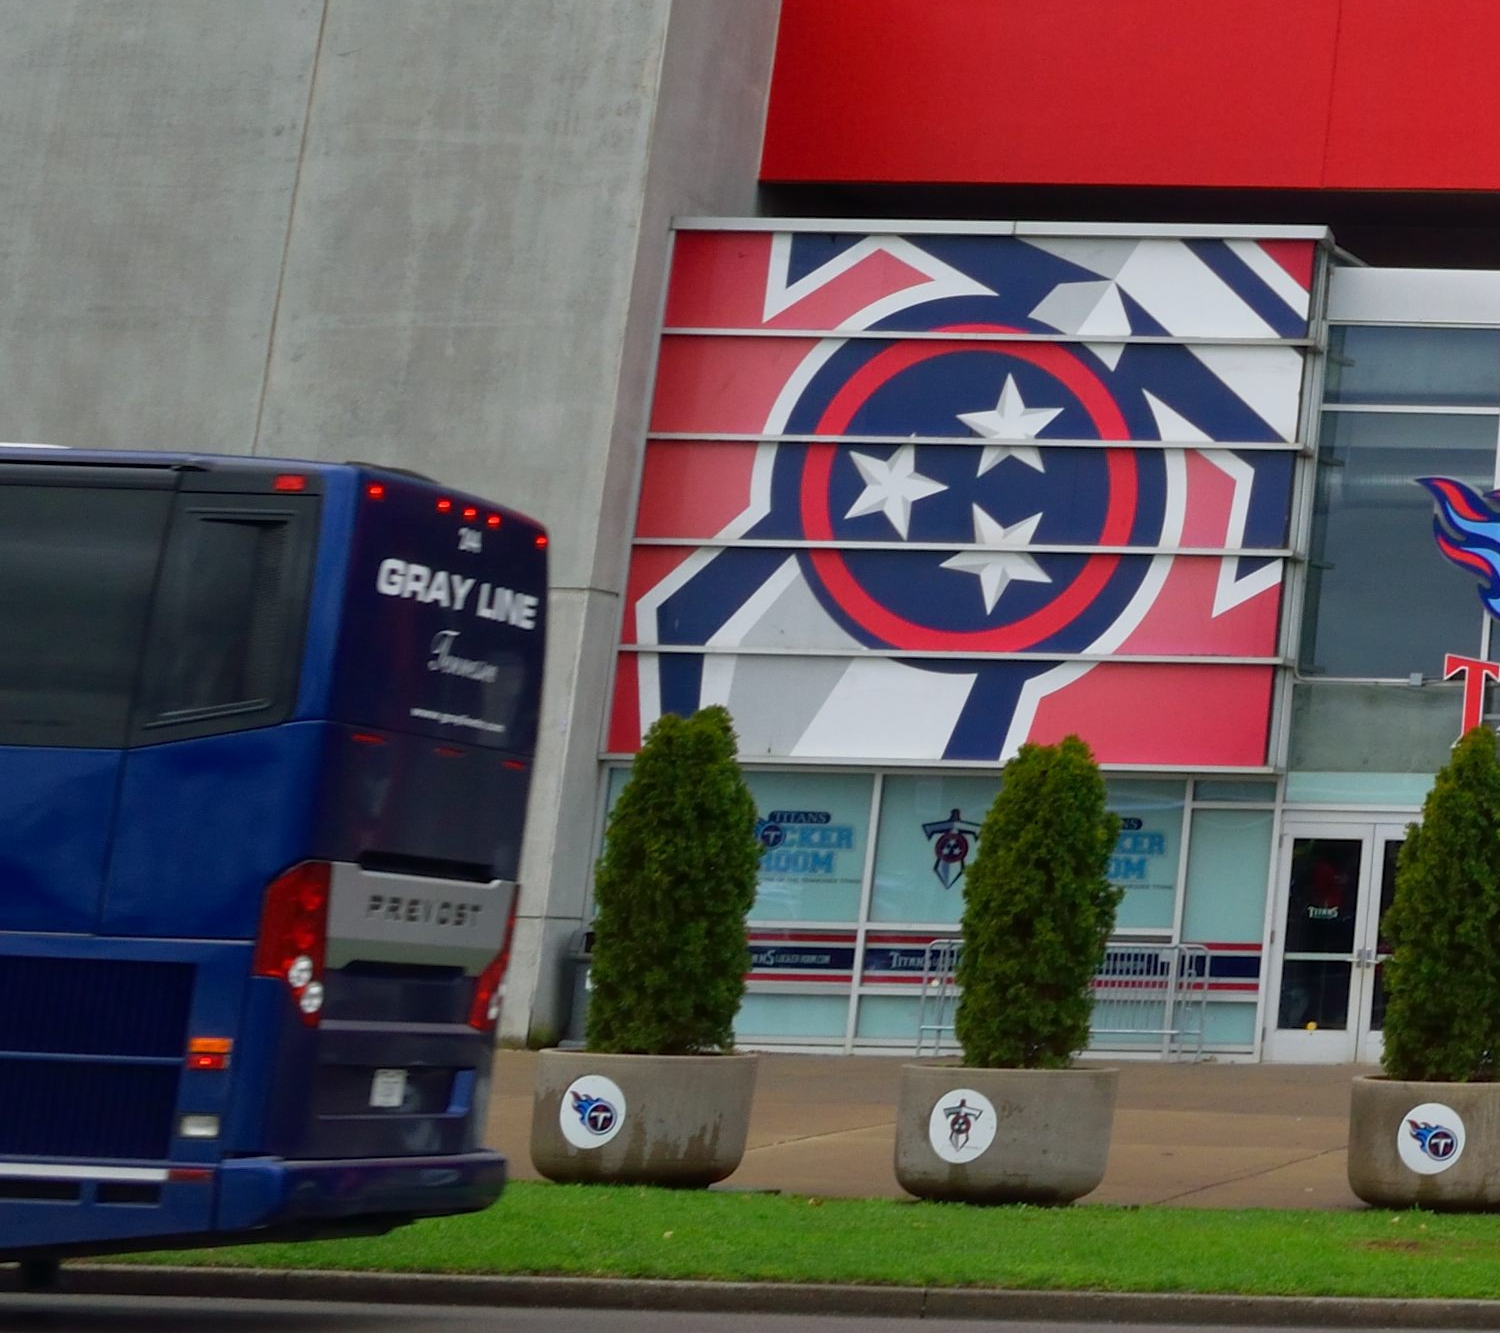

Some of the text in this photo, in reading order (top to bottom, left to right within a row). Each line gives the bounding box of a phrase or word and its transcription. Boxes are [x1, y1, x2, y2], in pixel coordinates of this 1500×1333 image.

[376, 557, 540, 631] GRAY LINE
[773, 812, 828, 824] TITANS
[366, 894, 483, 928] PREVOST
